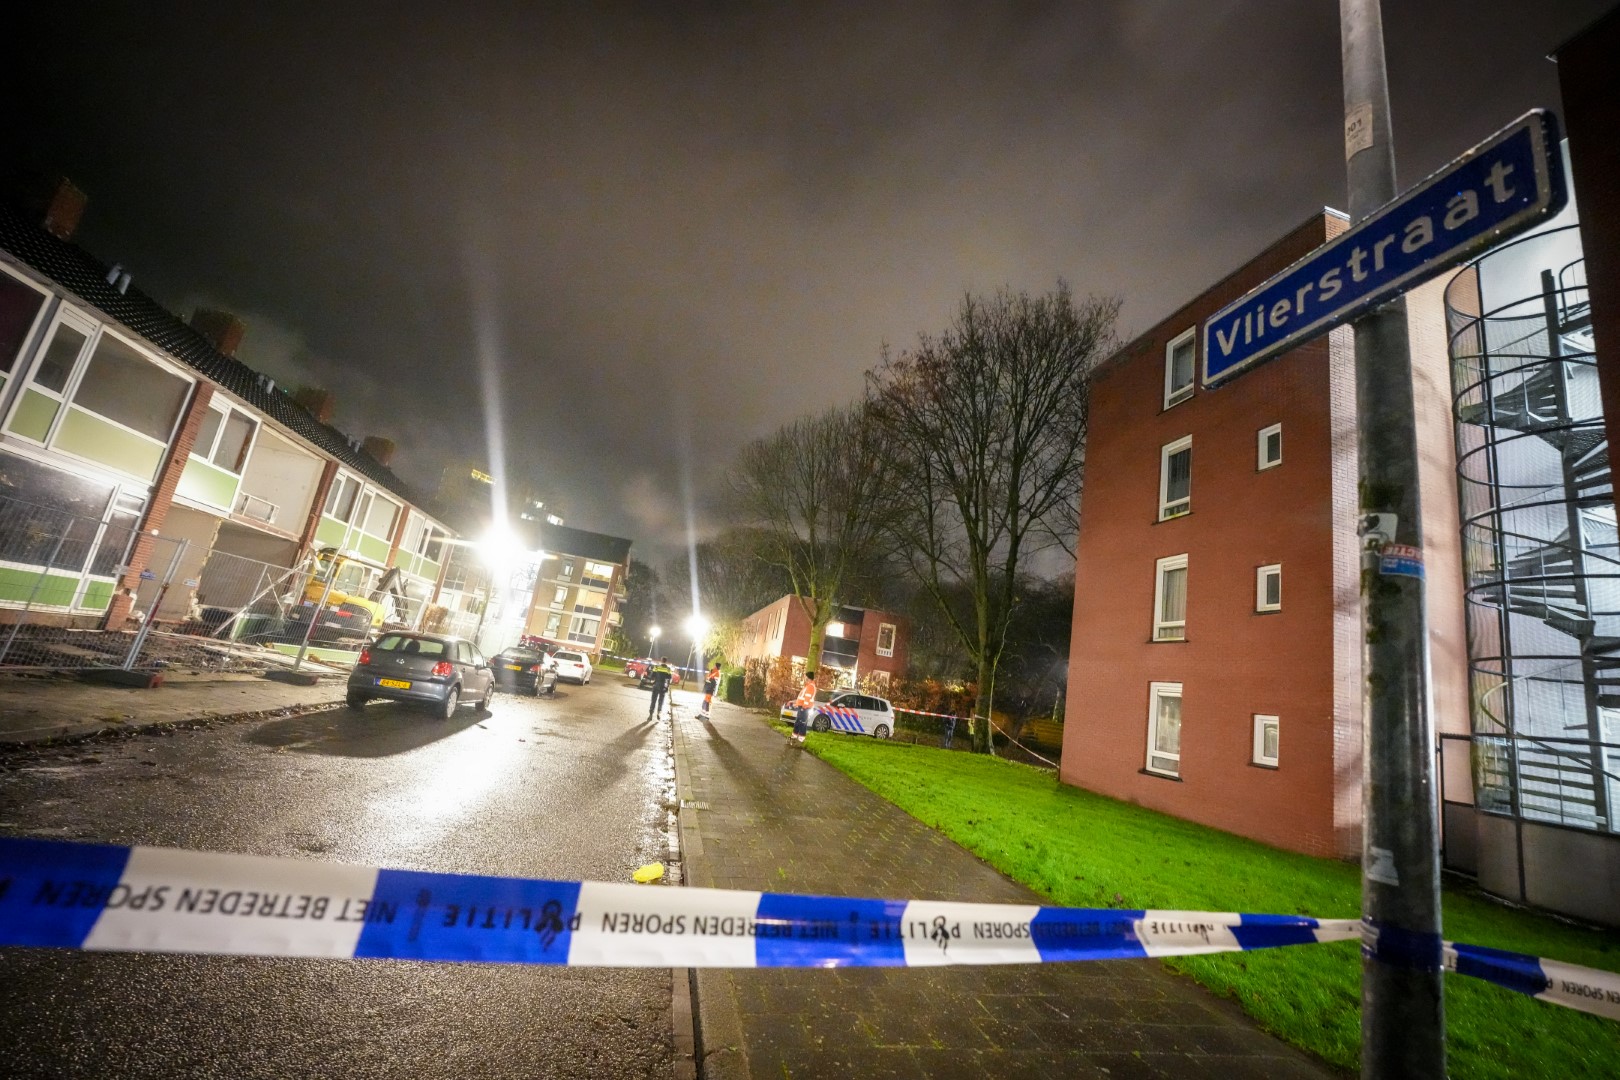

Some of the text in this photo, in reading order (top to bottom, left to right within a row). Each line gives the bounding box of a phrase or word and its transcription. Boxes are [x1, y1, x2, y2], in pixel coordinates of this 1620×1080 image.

[1215, 160, 1516, 357] Vlierstraat
[33, 877, 171, 913] SPOREN
[175, 887, 330, 922] BETREDEN
[334, 897, 399, 925] NIET
[601, 912, 686, 935] SPOREN
[693, 915, 793, 939] BETREDEN
[974, 921, 1031, 939] SPOREN
[1562, 980, 1604, 1001] SPOREN
